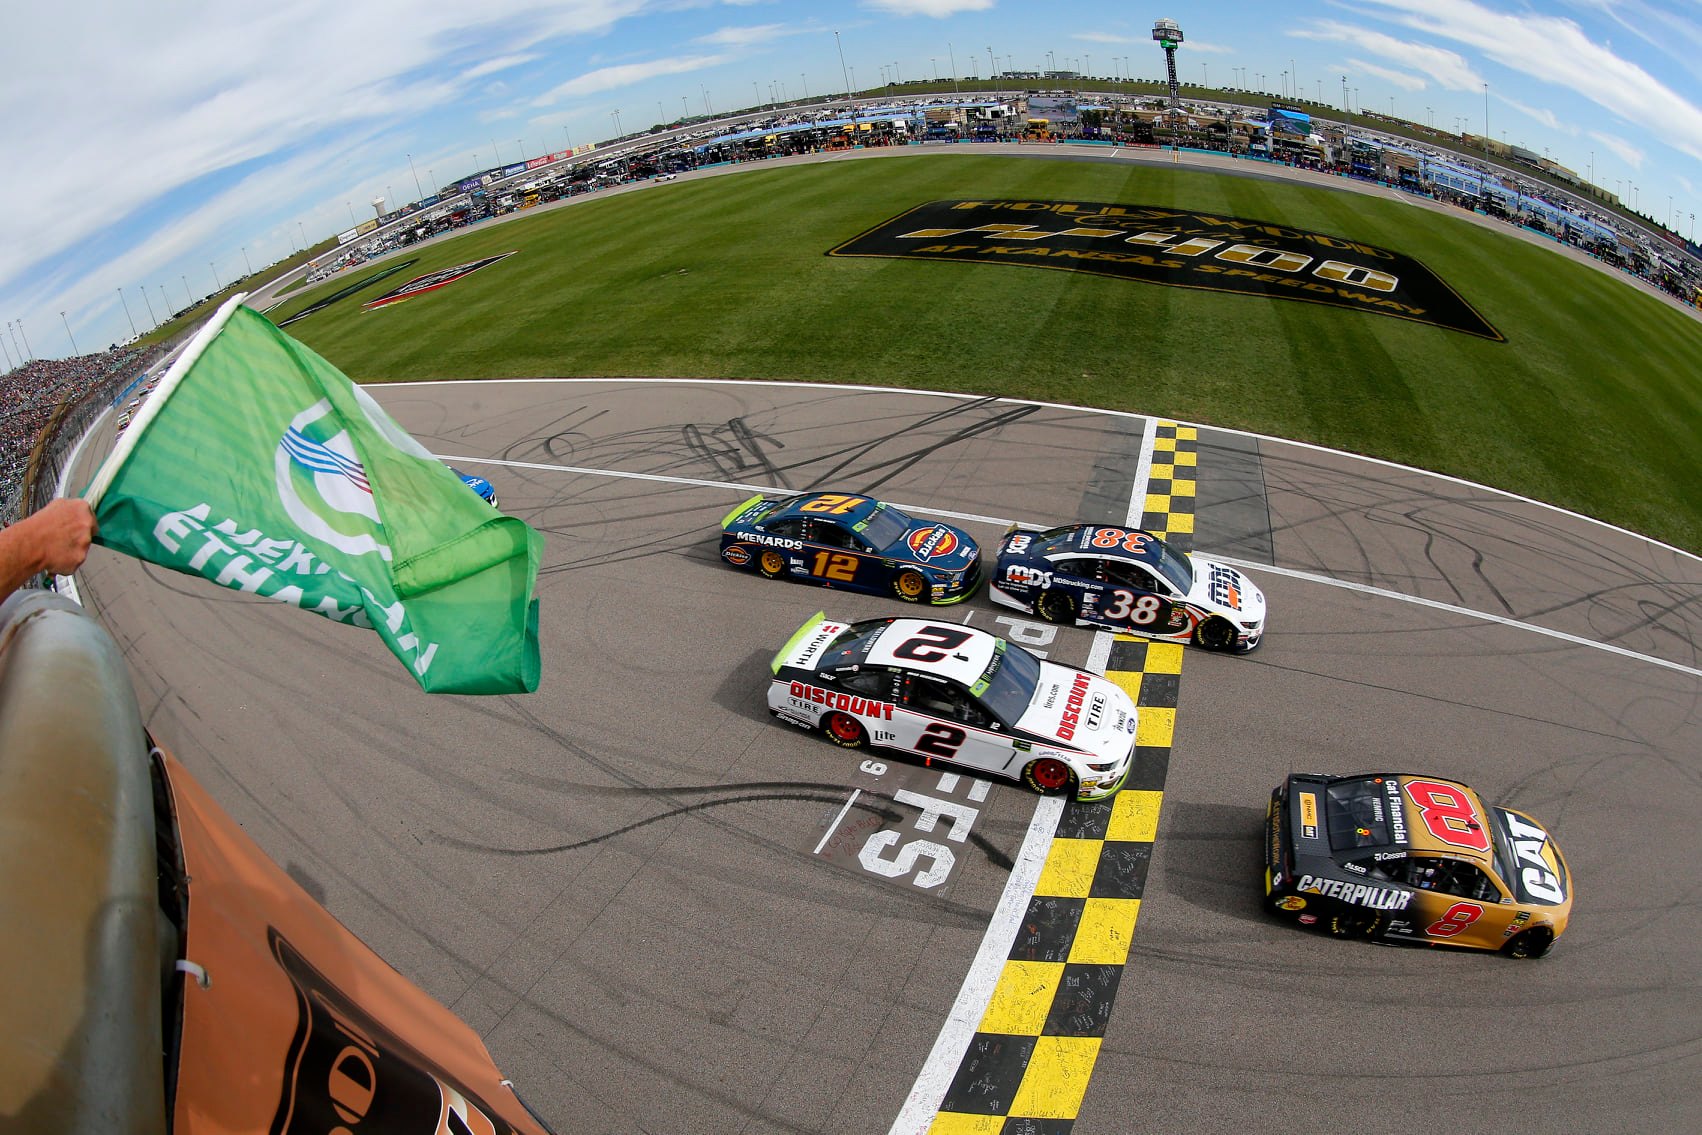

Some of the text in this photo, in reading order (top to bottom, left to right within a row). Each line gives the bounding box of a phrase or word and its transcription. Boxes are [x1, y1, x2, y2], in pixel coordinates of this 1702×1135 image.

[951, 201, 1396, 261] HOLLYWOOD
[1124, 231, 1399, 293] 400
[911, 244, 1428, 316] AT KANSAS SPEEDWAY
[800, 494, 866, 515] 12
[736, 531, 803, 550] MENARDS
[919, 527, 947, 558] Dickies
[1006, 534, 1032, 555] MDS
[1091, 527, 1154, 555] 38
[812, 550, 860, 582] 12
[1006, 564, 1054, 589] MDS
[1053, 576, 1104, 591] MDStrucking.com
[1206, 562, 1243, 612] MDS
[1103, 589, 1161, 625] 38
[795, 634, 830, 665] WÜRTH
[892, 625, 975, 663] 2
[790, 680, 896, 721] DISCOUNT
[791, 698, 820, 714] TIRE
[1043, 683, 1060, 709] tires.com
[1055, 673, 1092, 741] DISCOUNT
[1087, 695, 1105, 728] TIRE
[874, 730, 897, 742] Lite
[913, 722, 967, 759] 2
[1385, 780, 1408, 844] Cat Financial
[1402, 780, 1491, 853] 8
[1381, 851, 1407, 861] Cessna
[1504, 811, 1565, 904] CAT
[1297, 874, 1413, 911] CATERPILLAR
[1424, 901, 1486, 938] 8
